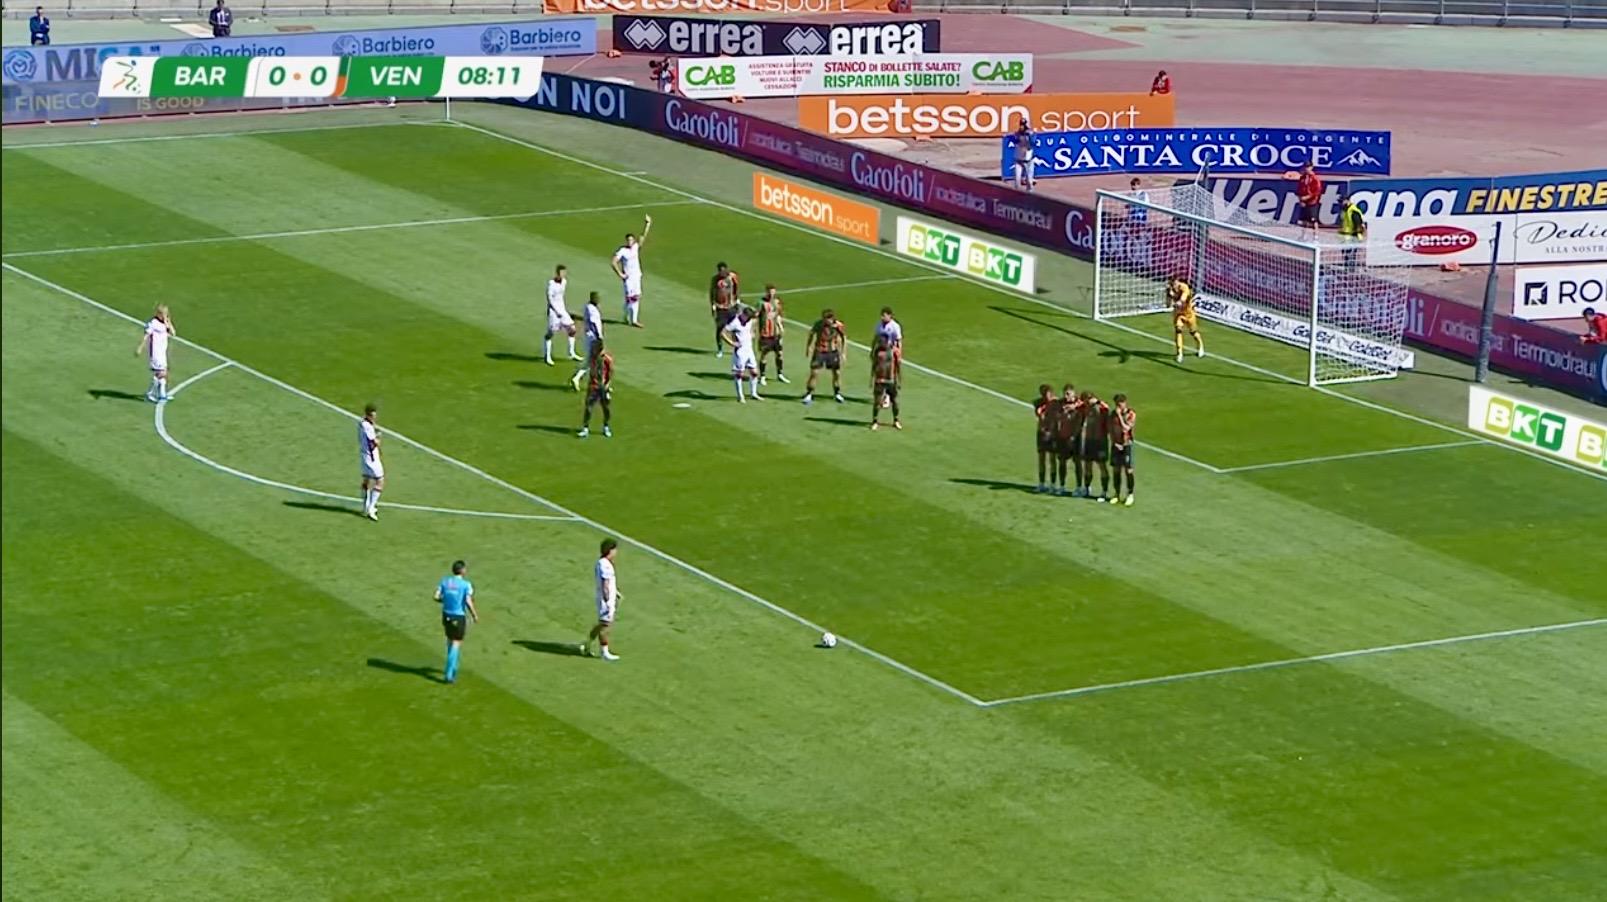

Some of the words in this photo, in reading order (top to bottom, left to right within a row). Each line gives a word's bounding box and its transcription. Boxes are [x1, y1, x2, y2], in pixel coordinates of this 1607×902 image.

[362, 36, 435, 54] Barbiero
[510, 28, 581, 45] Barbiero
[685, 65, 736, 86] CAB
[824, 62, 866, 73] STANCO
[868, 63, 878, 72] DI
[880, 62, 922, 72] BOLLETTE
[925, 62, 962, 72] SALATE?
[972, 61, 1025, 81] CAB
[824, 74, 900, 88] RISPARMIA
[904, 73, 961, 87] SUBITO!
[15, 92, 100, 113] FINECO
[137, 99, 149, 111] IS
[156, 96, 204, 109] GOOD
[572, 80, 625, 120] NOI
[665, 99, 739, 148] Garofoli
[1008, 137, 1066, 148] AQUA
[1080, 133, 1236, 144] OLIGOMINERALE
[1251, 134, 1270, 142] DI
[1285, 134, 1385, 145] SORGENTE
[1054, 144, 1183, 171] SANTA
[1191, 143, 1333, 169] CROCE
[850, 152, 925, 203] Garofoli
[1466, 181, 1607, 213] FINESTRE
[1400, 233, 1471, 250] granoro
[1571, 244, 1607, 254] NOSTR
[908, 227, 960, 265] BKT
[969, 245, 1022, 284] BKT
[1558, 279, 1607, 305] RO
[1488, 402, 1564, 449] BKT
[1578, 429, 1607, 460] B
